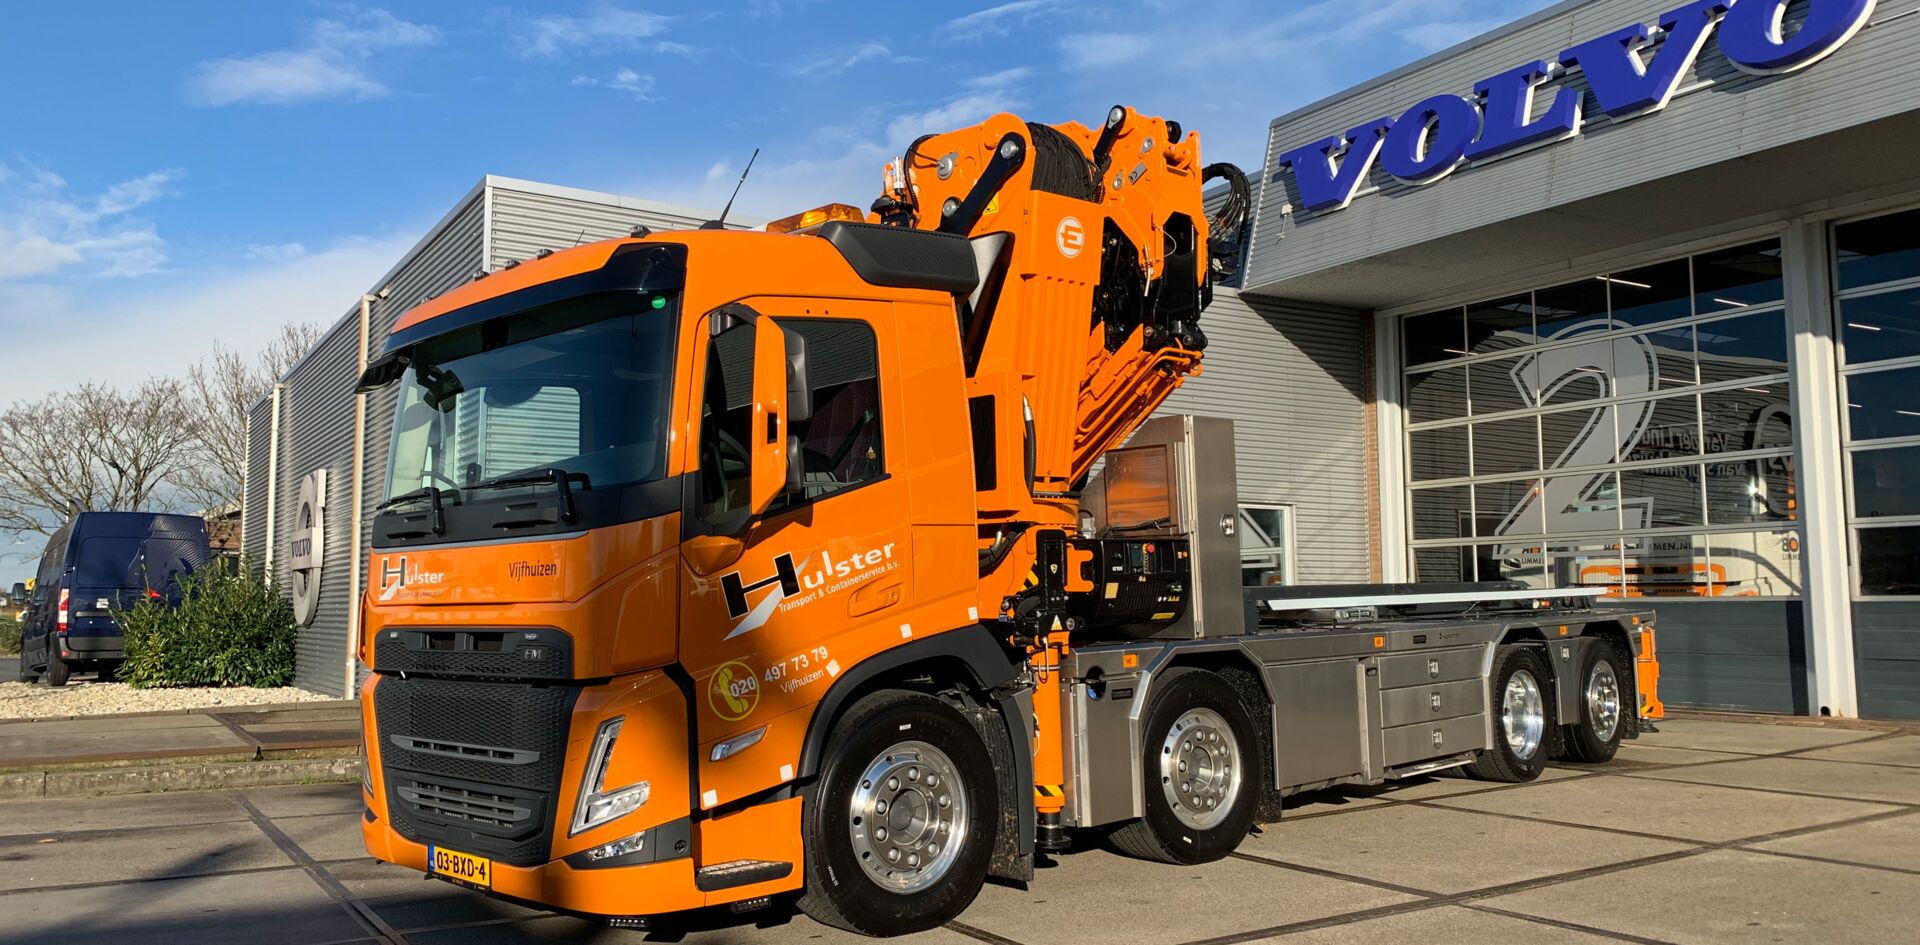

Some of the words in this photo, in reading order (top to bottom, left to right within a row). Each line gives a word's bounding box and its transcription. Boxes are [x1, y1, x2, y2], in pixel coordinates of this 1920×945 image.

[1280, 0, 1875, 213] VOLVO
[1492, 318, 1659, 560] 2
[291, 537, 311, 558] VOLVO
[380, 555, 444, 590] Hulster
[508, 560, 557, 582] Vijfhuizen
[720, 542, 895, 620] Hulster
[778, 592, 817, 613] Transport
[818, 588, 825, 598] &
[826, 565, 886, 595] Containerservice
[886, 559, 900, 574] b.v.
[729, 676, 757, 697] 020
[764, 663, 787, 683] 497
[791, 655, 809, 671] 73
[811, 646, 829, 663] 79
[780, 669, 824, 694] Vijfhuizen
[436, 851, 487, 881] 03-BXD-4
